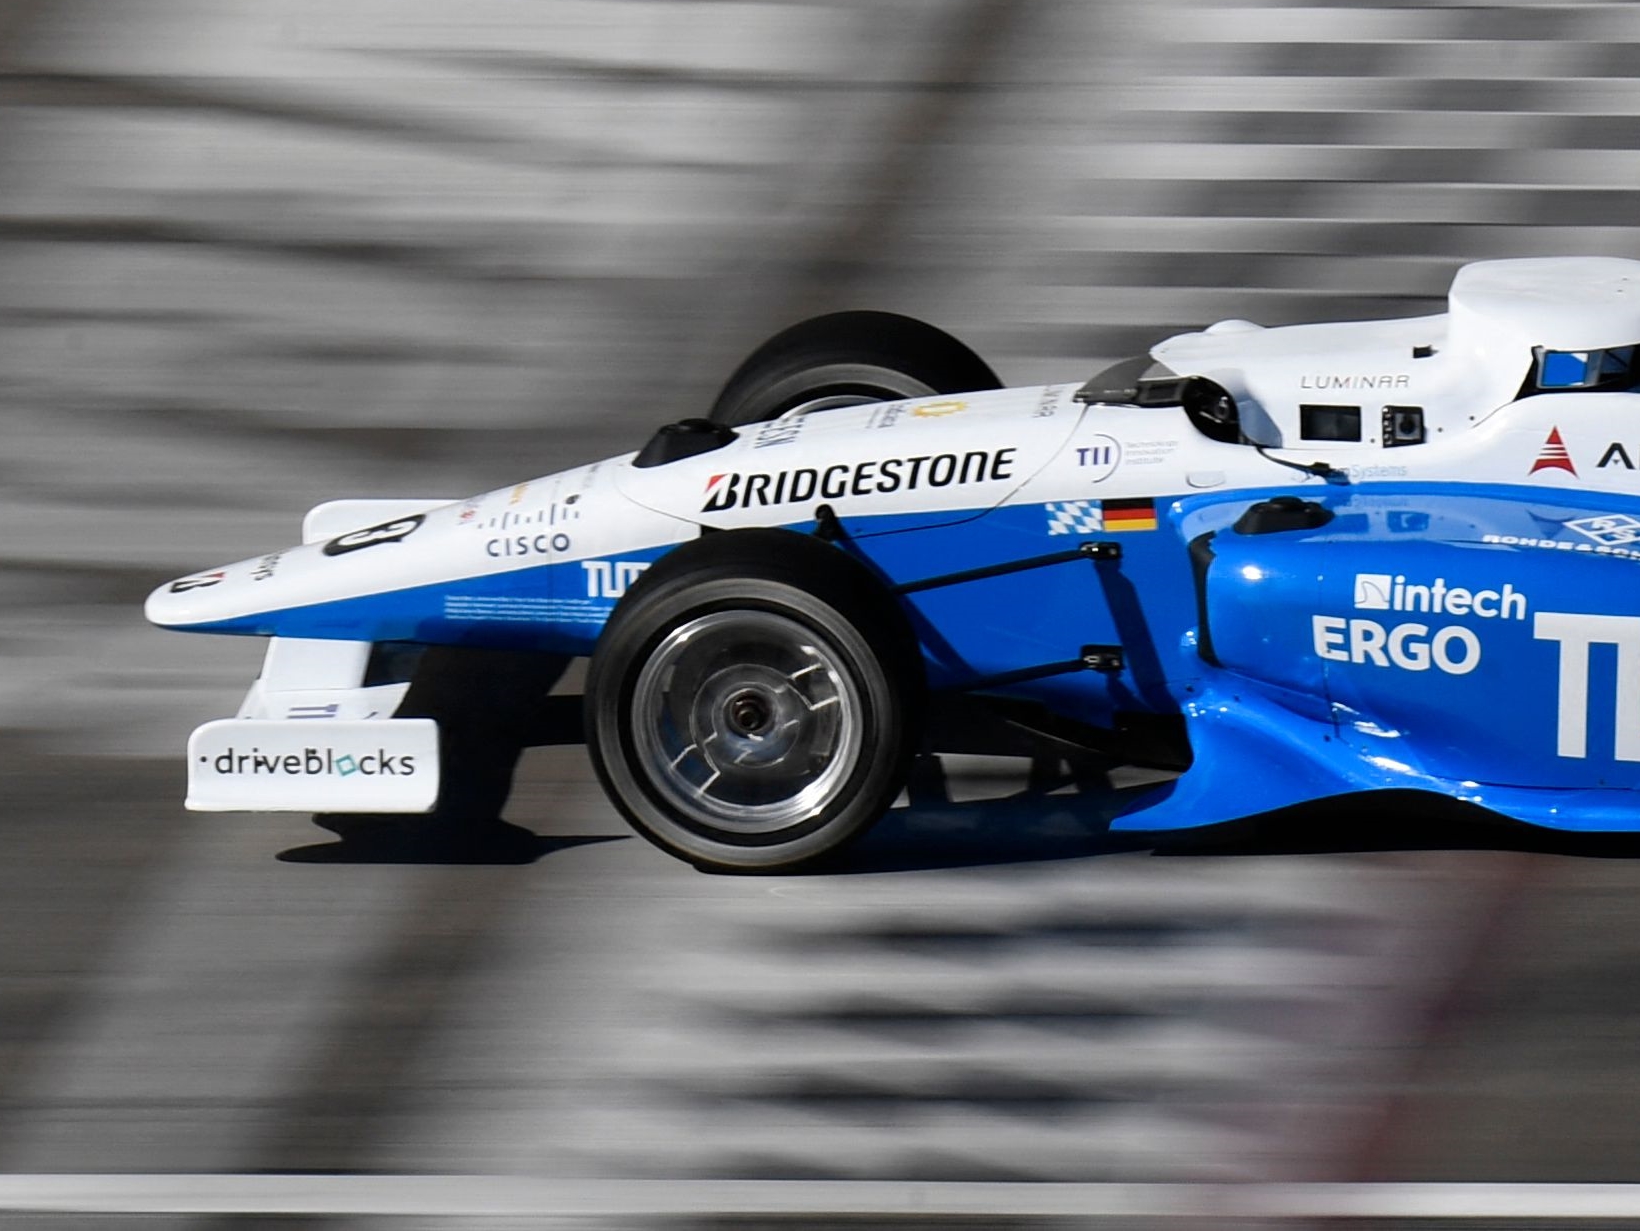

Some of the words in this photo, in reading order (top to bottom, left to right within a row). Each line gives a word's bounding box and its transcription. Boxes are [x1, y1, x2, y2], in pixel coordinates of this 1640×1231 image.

[1300, 375, 1411, 389] LUMINAR
[1075, 446, 1111, 466] TII
[702, 447, 1017, 512] BRIDGESTONE
[487, 533, 570, 557] CISCO
[1393, 575, 1527, 621] intech
[1312, 614, 1480, 675] ERGO
